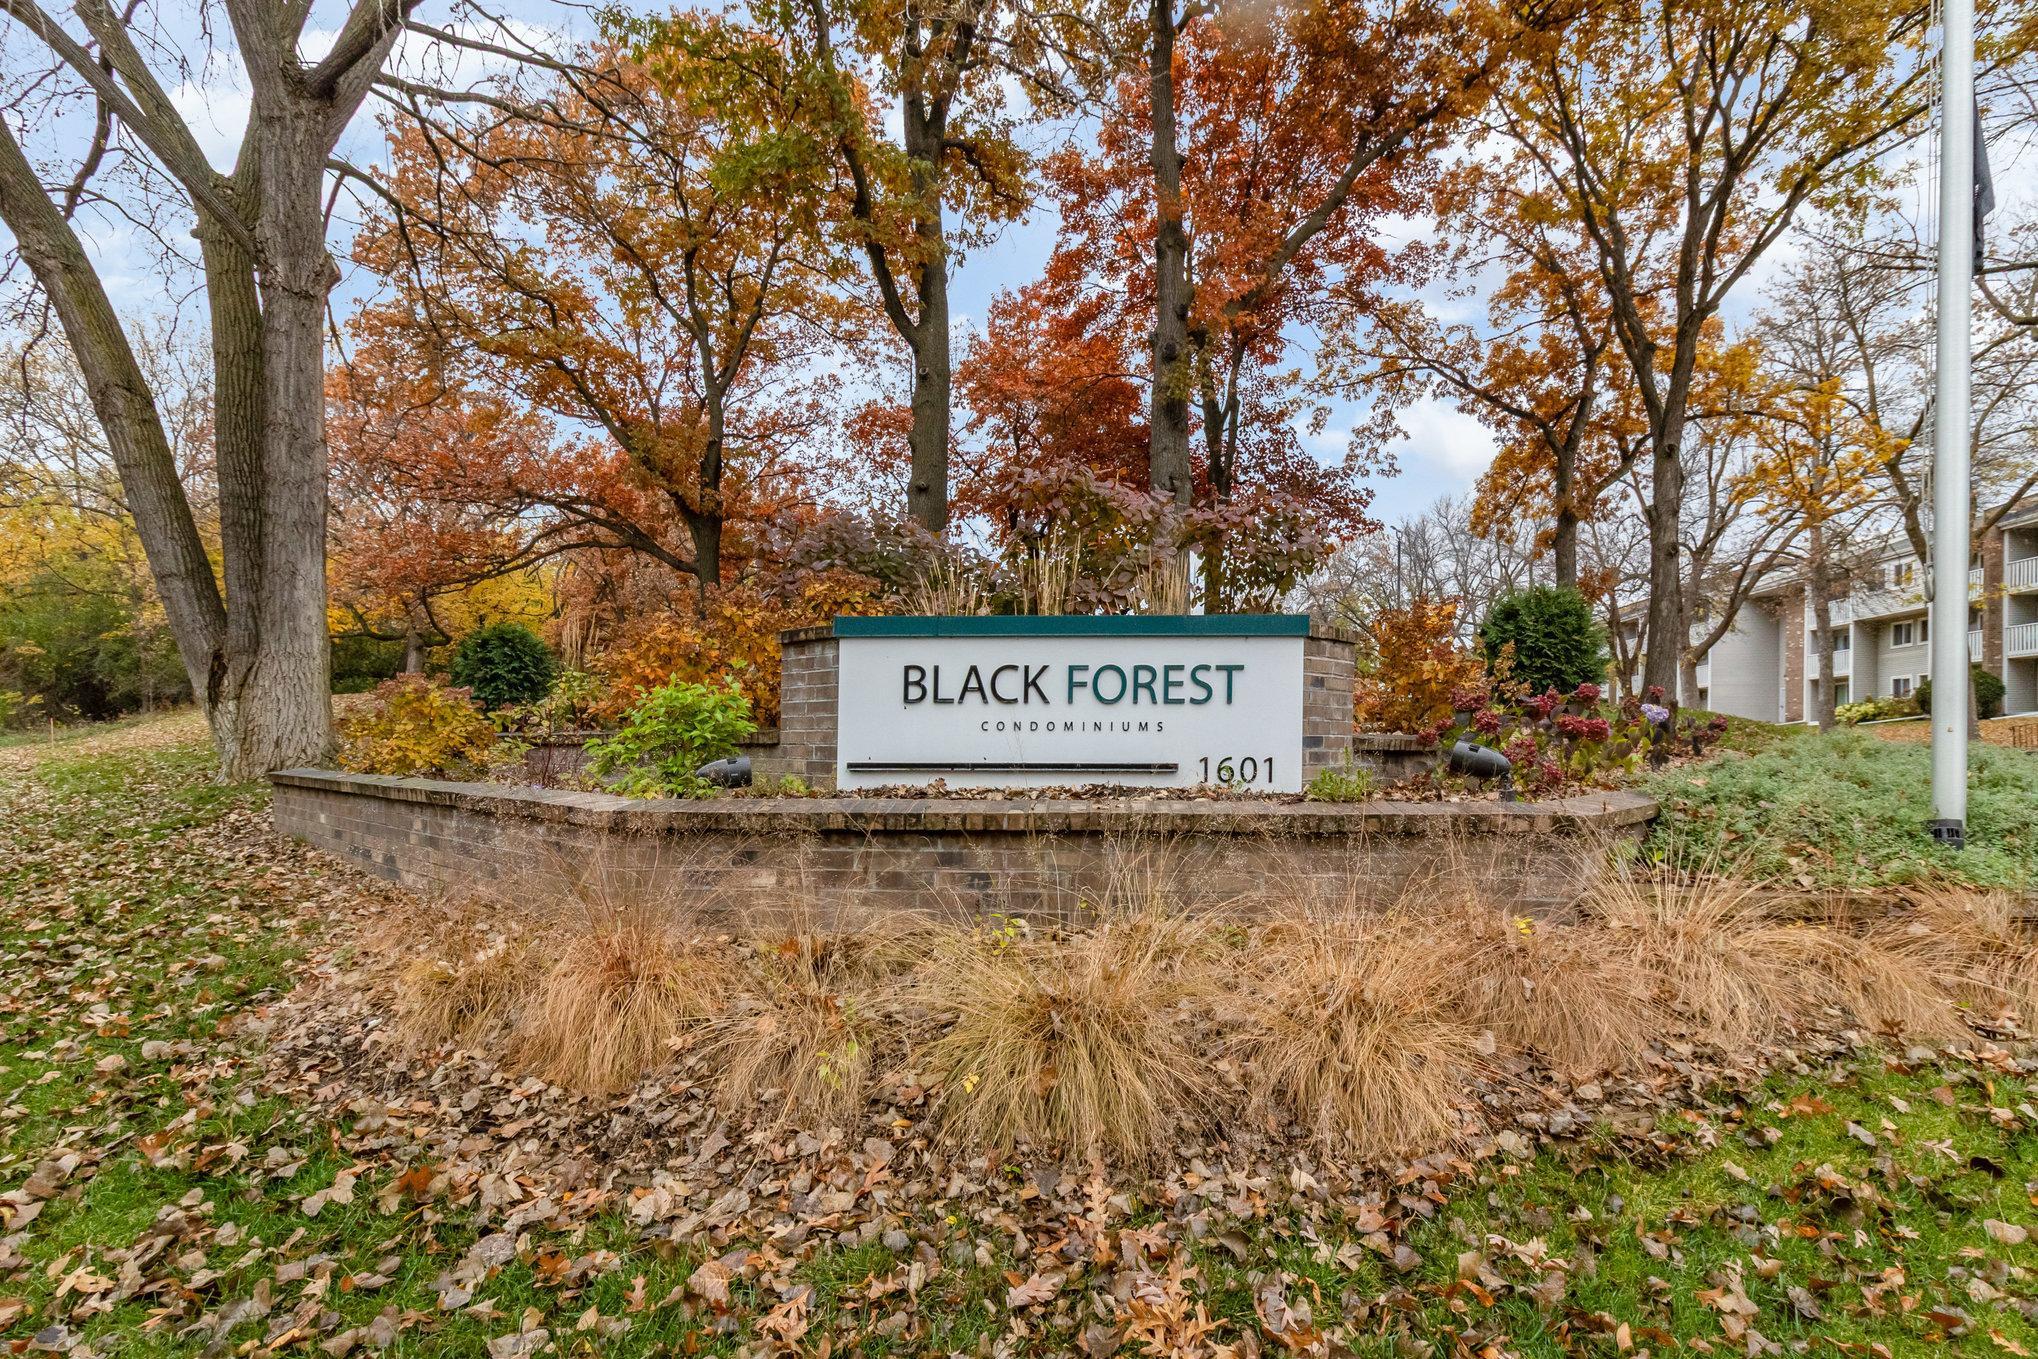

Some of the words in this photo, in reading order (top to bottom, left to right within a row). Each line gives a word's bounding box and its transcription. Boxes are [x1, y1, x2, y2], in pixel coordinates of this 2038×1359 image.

[903, 664, 1050, 706] BLACK
[1067, 663, 1245, 706] FOREST
[980, 720, 1165, 733] CONDOMINIUMS
[1198, 756, 1274, 784] 1601
